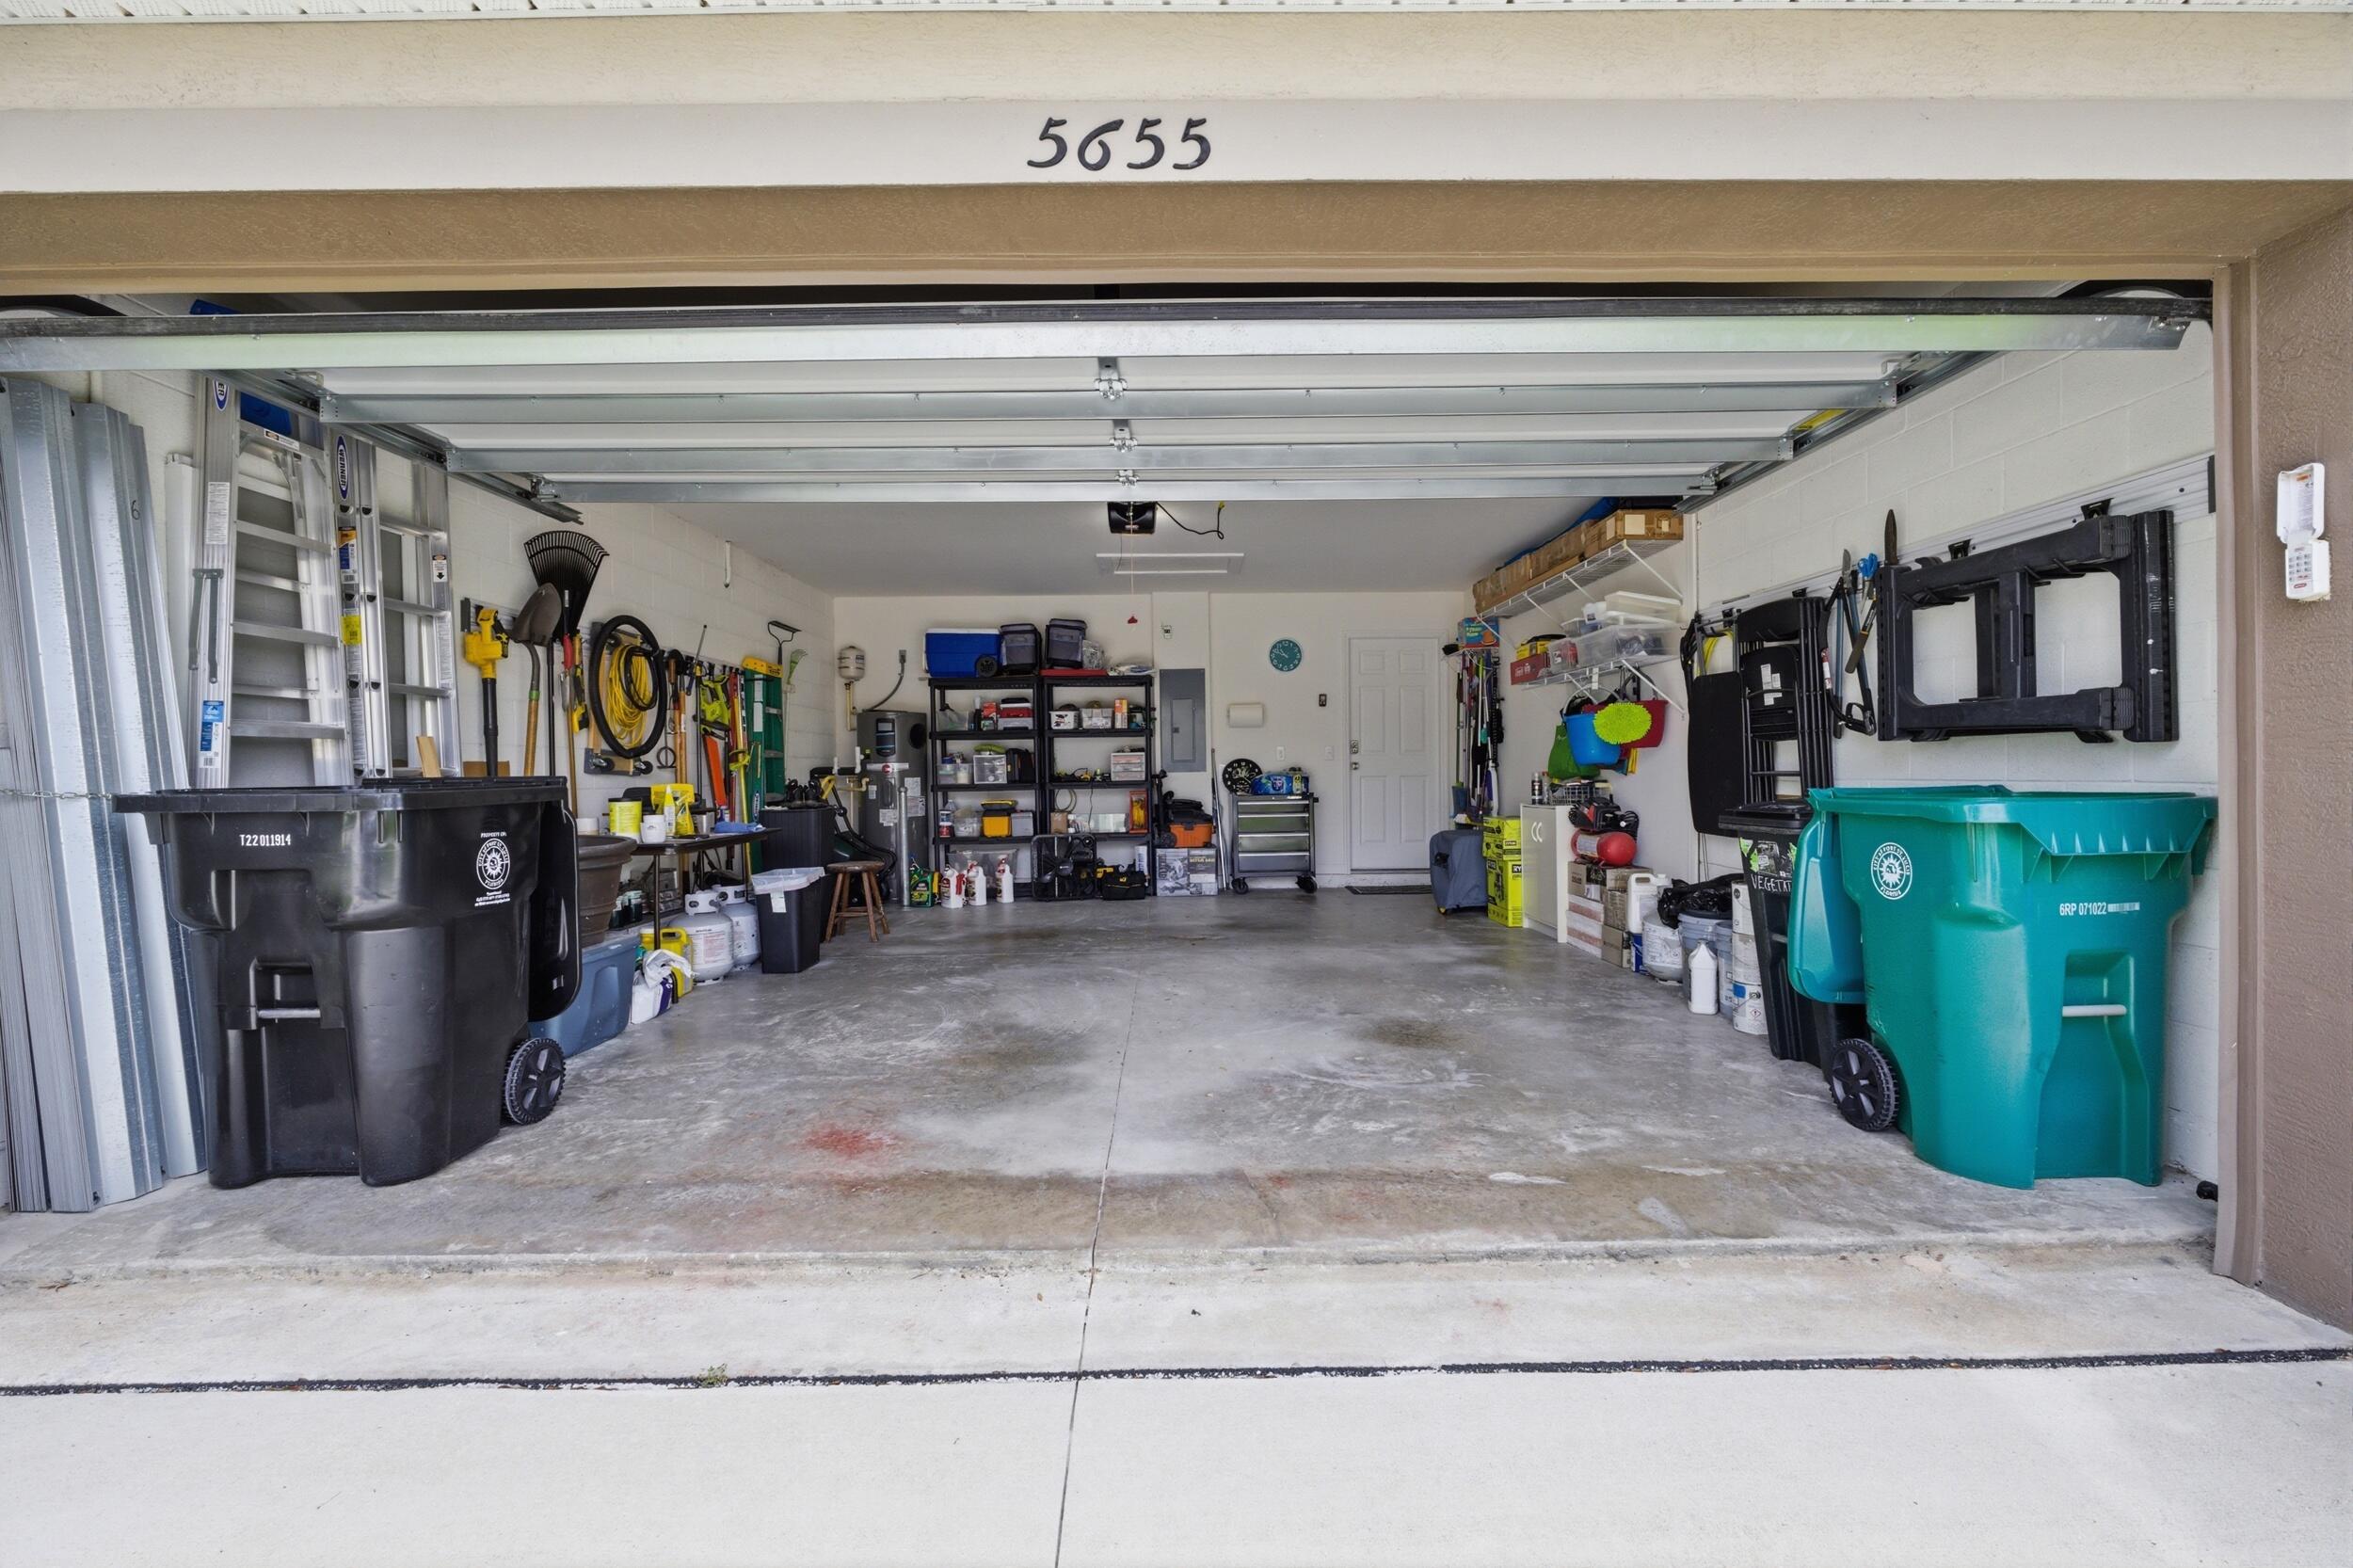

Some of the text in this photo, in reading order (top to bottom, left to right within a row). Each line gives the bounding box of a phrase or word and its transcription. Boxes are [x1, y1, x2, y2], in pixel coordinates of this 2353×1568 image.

[1027, 117, 1211, 171] 5655
[338, 447, 347, 488] WERNER
[2059, 902, 2107, 916] 6RP 071022
